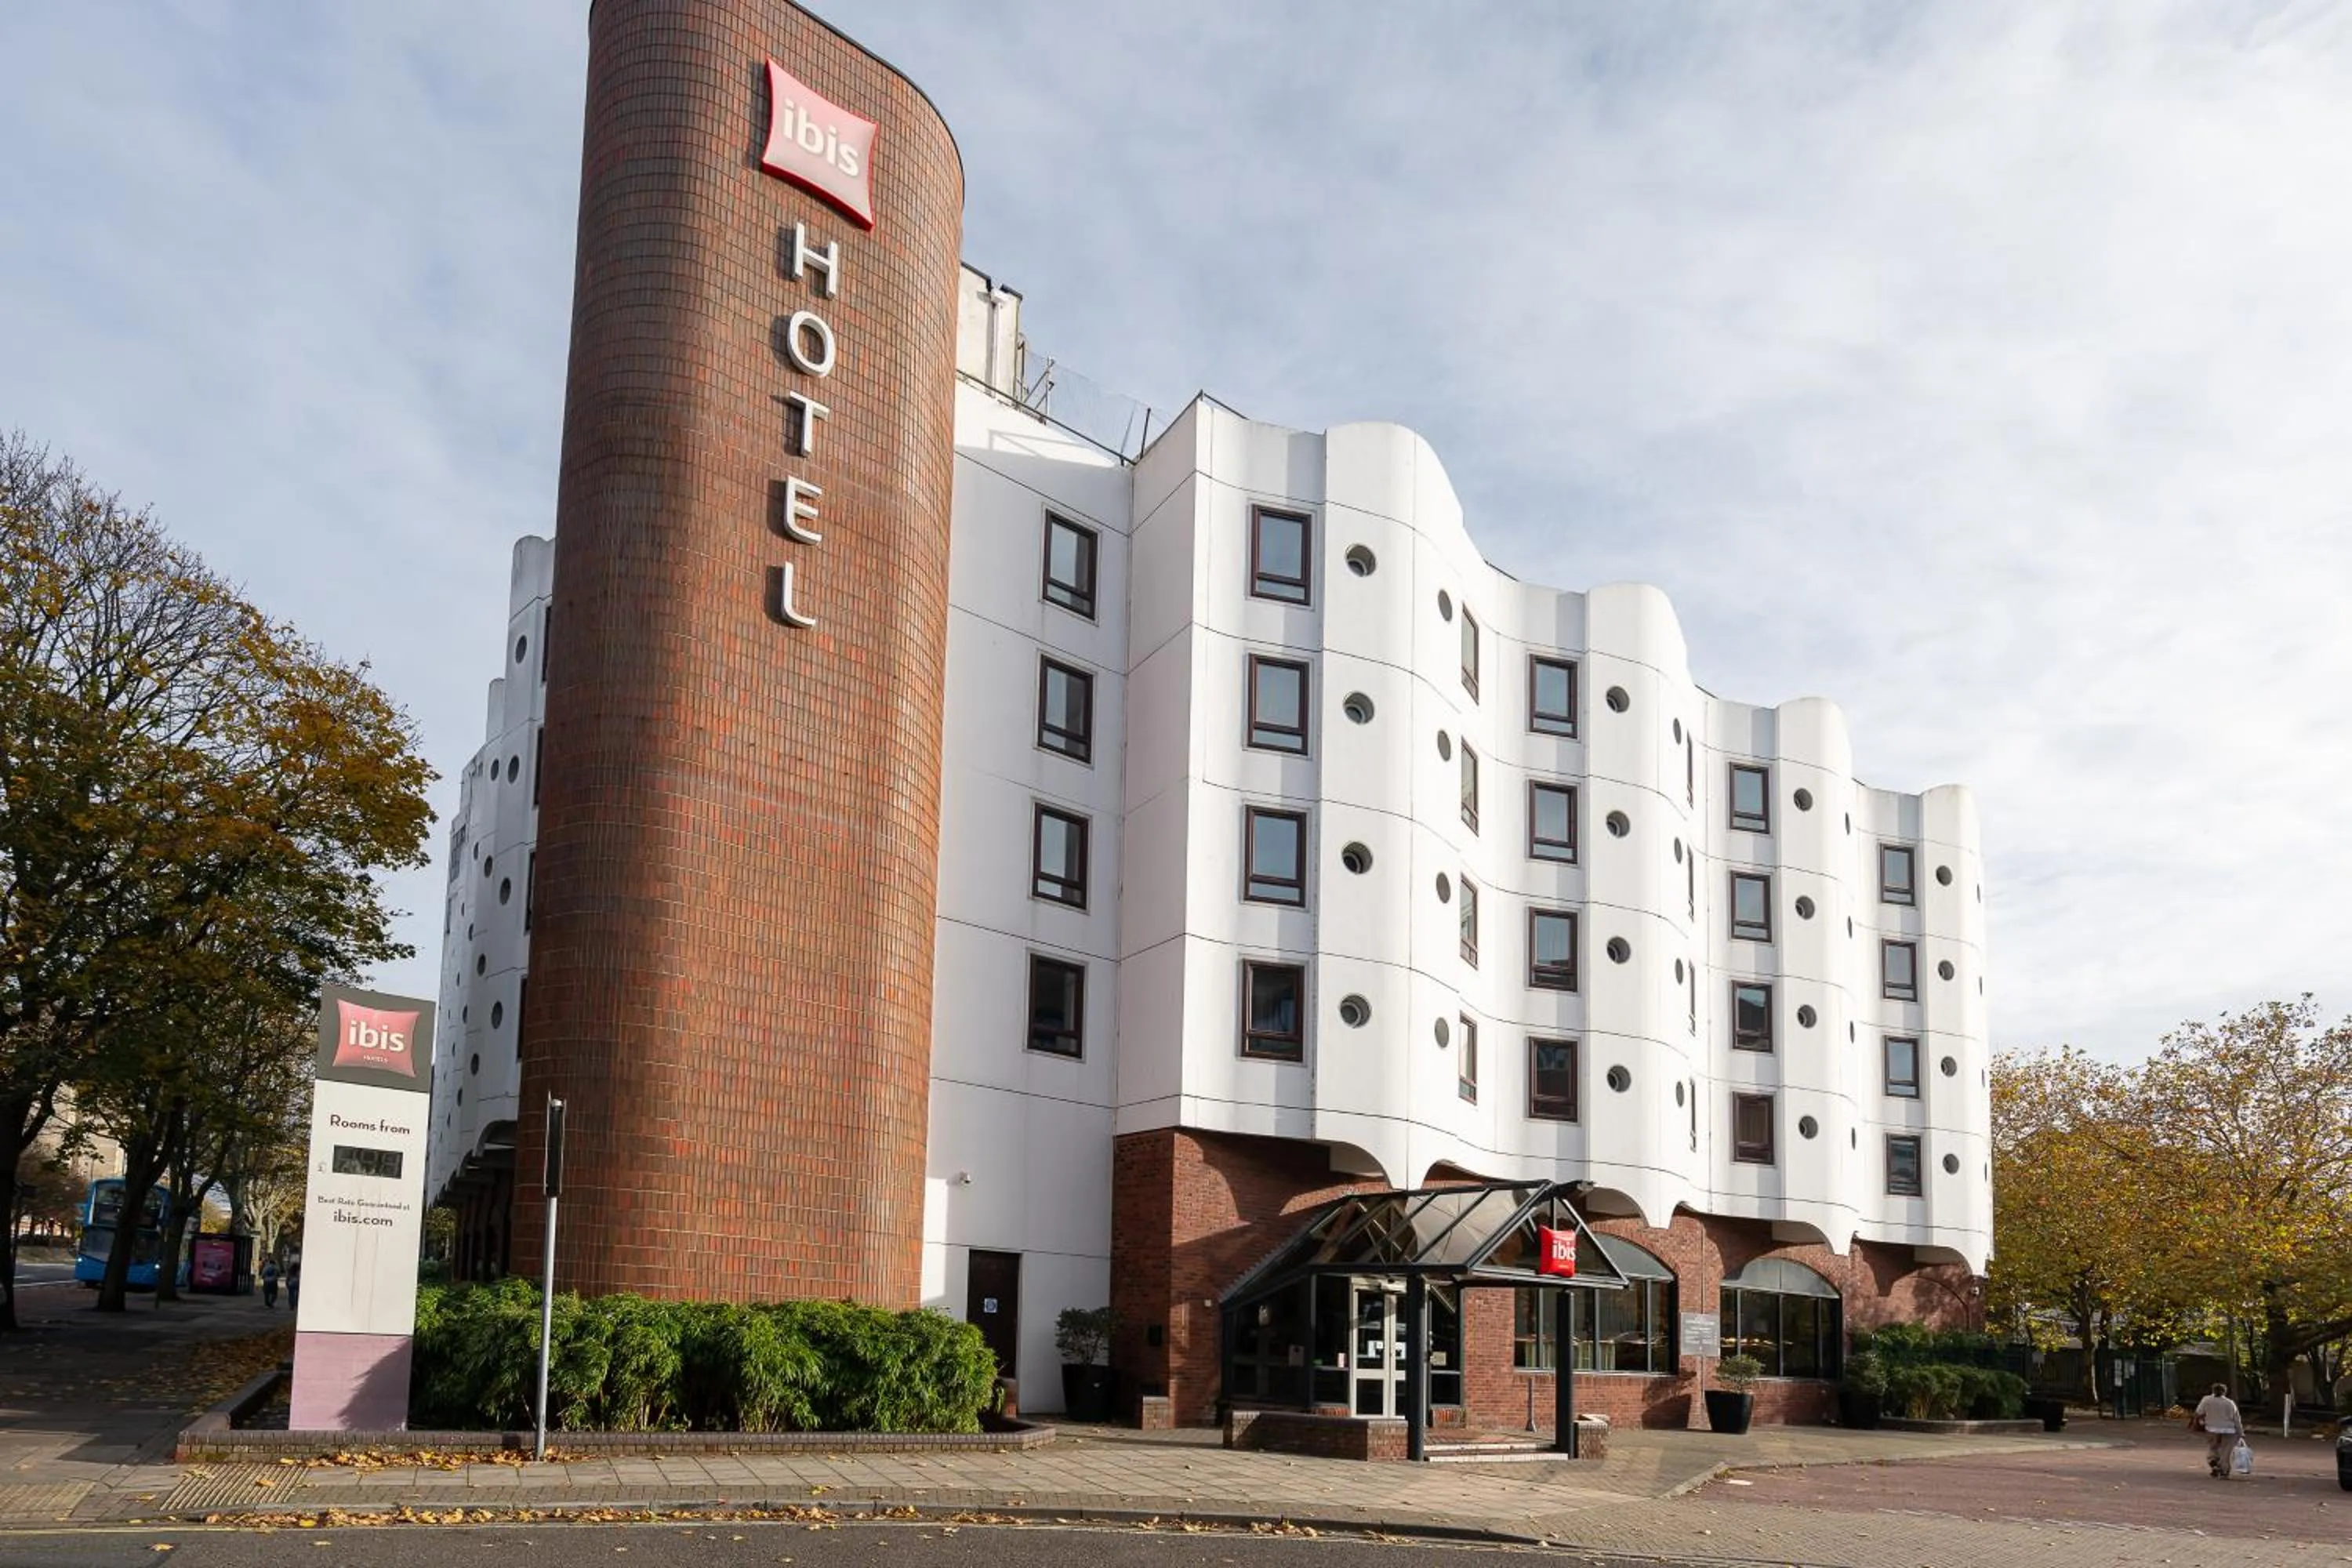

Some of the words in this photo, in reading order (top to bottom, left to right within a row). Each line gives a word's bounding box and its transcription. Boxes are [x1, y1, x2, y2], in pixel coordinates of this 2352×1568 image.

[783, 97, 858, 176] ibis
[782, 222, 839, 628] HOTEL
[349, 1020, 405, 1052] ibis
[329, 1114, 376, 1131] Rooms
[379, 1119, 410, 1134] from
[337, 1197, 355, 1206] Rate
[333, 1208, 393, 1227] ibis.com
[1552, 1240, 1576, 1261] ibis
